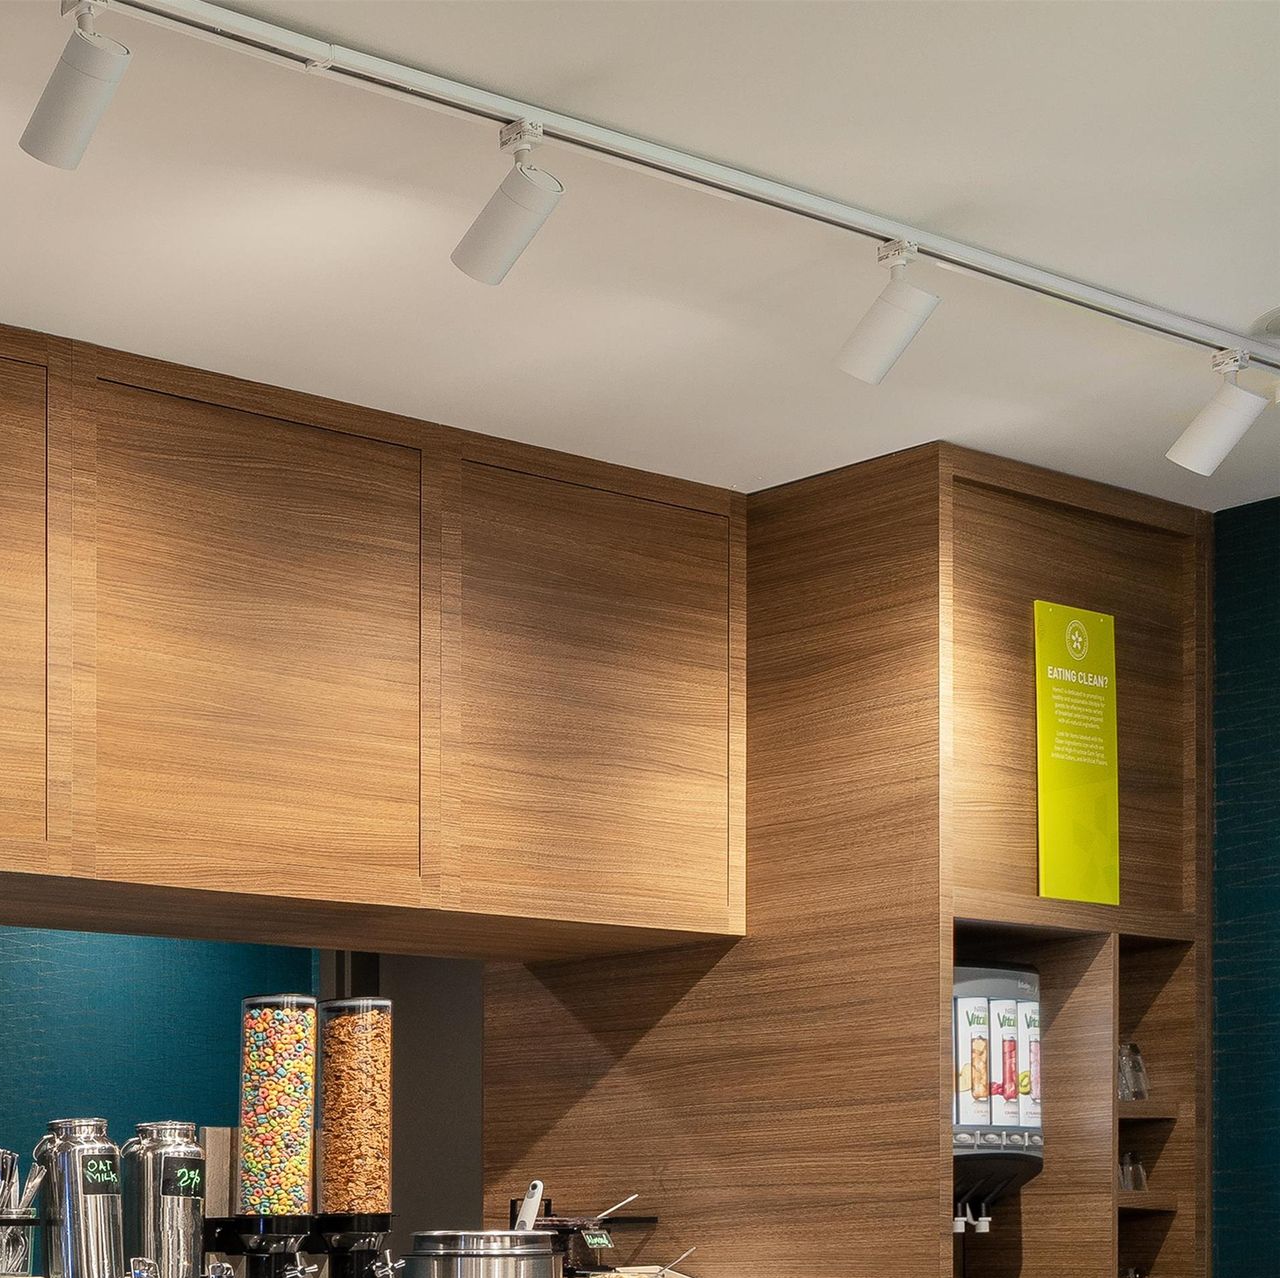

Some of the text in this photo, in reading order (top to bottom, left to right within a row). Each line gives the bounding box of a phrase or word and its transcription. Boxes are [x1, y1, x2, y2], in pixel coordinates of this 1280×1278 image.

[1048, 666, 1109, 689] EATING CLEAN?
[87, 1160, 113, 1171] OAT
[86, 1171, 118, 1183] MILK
